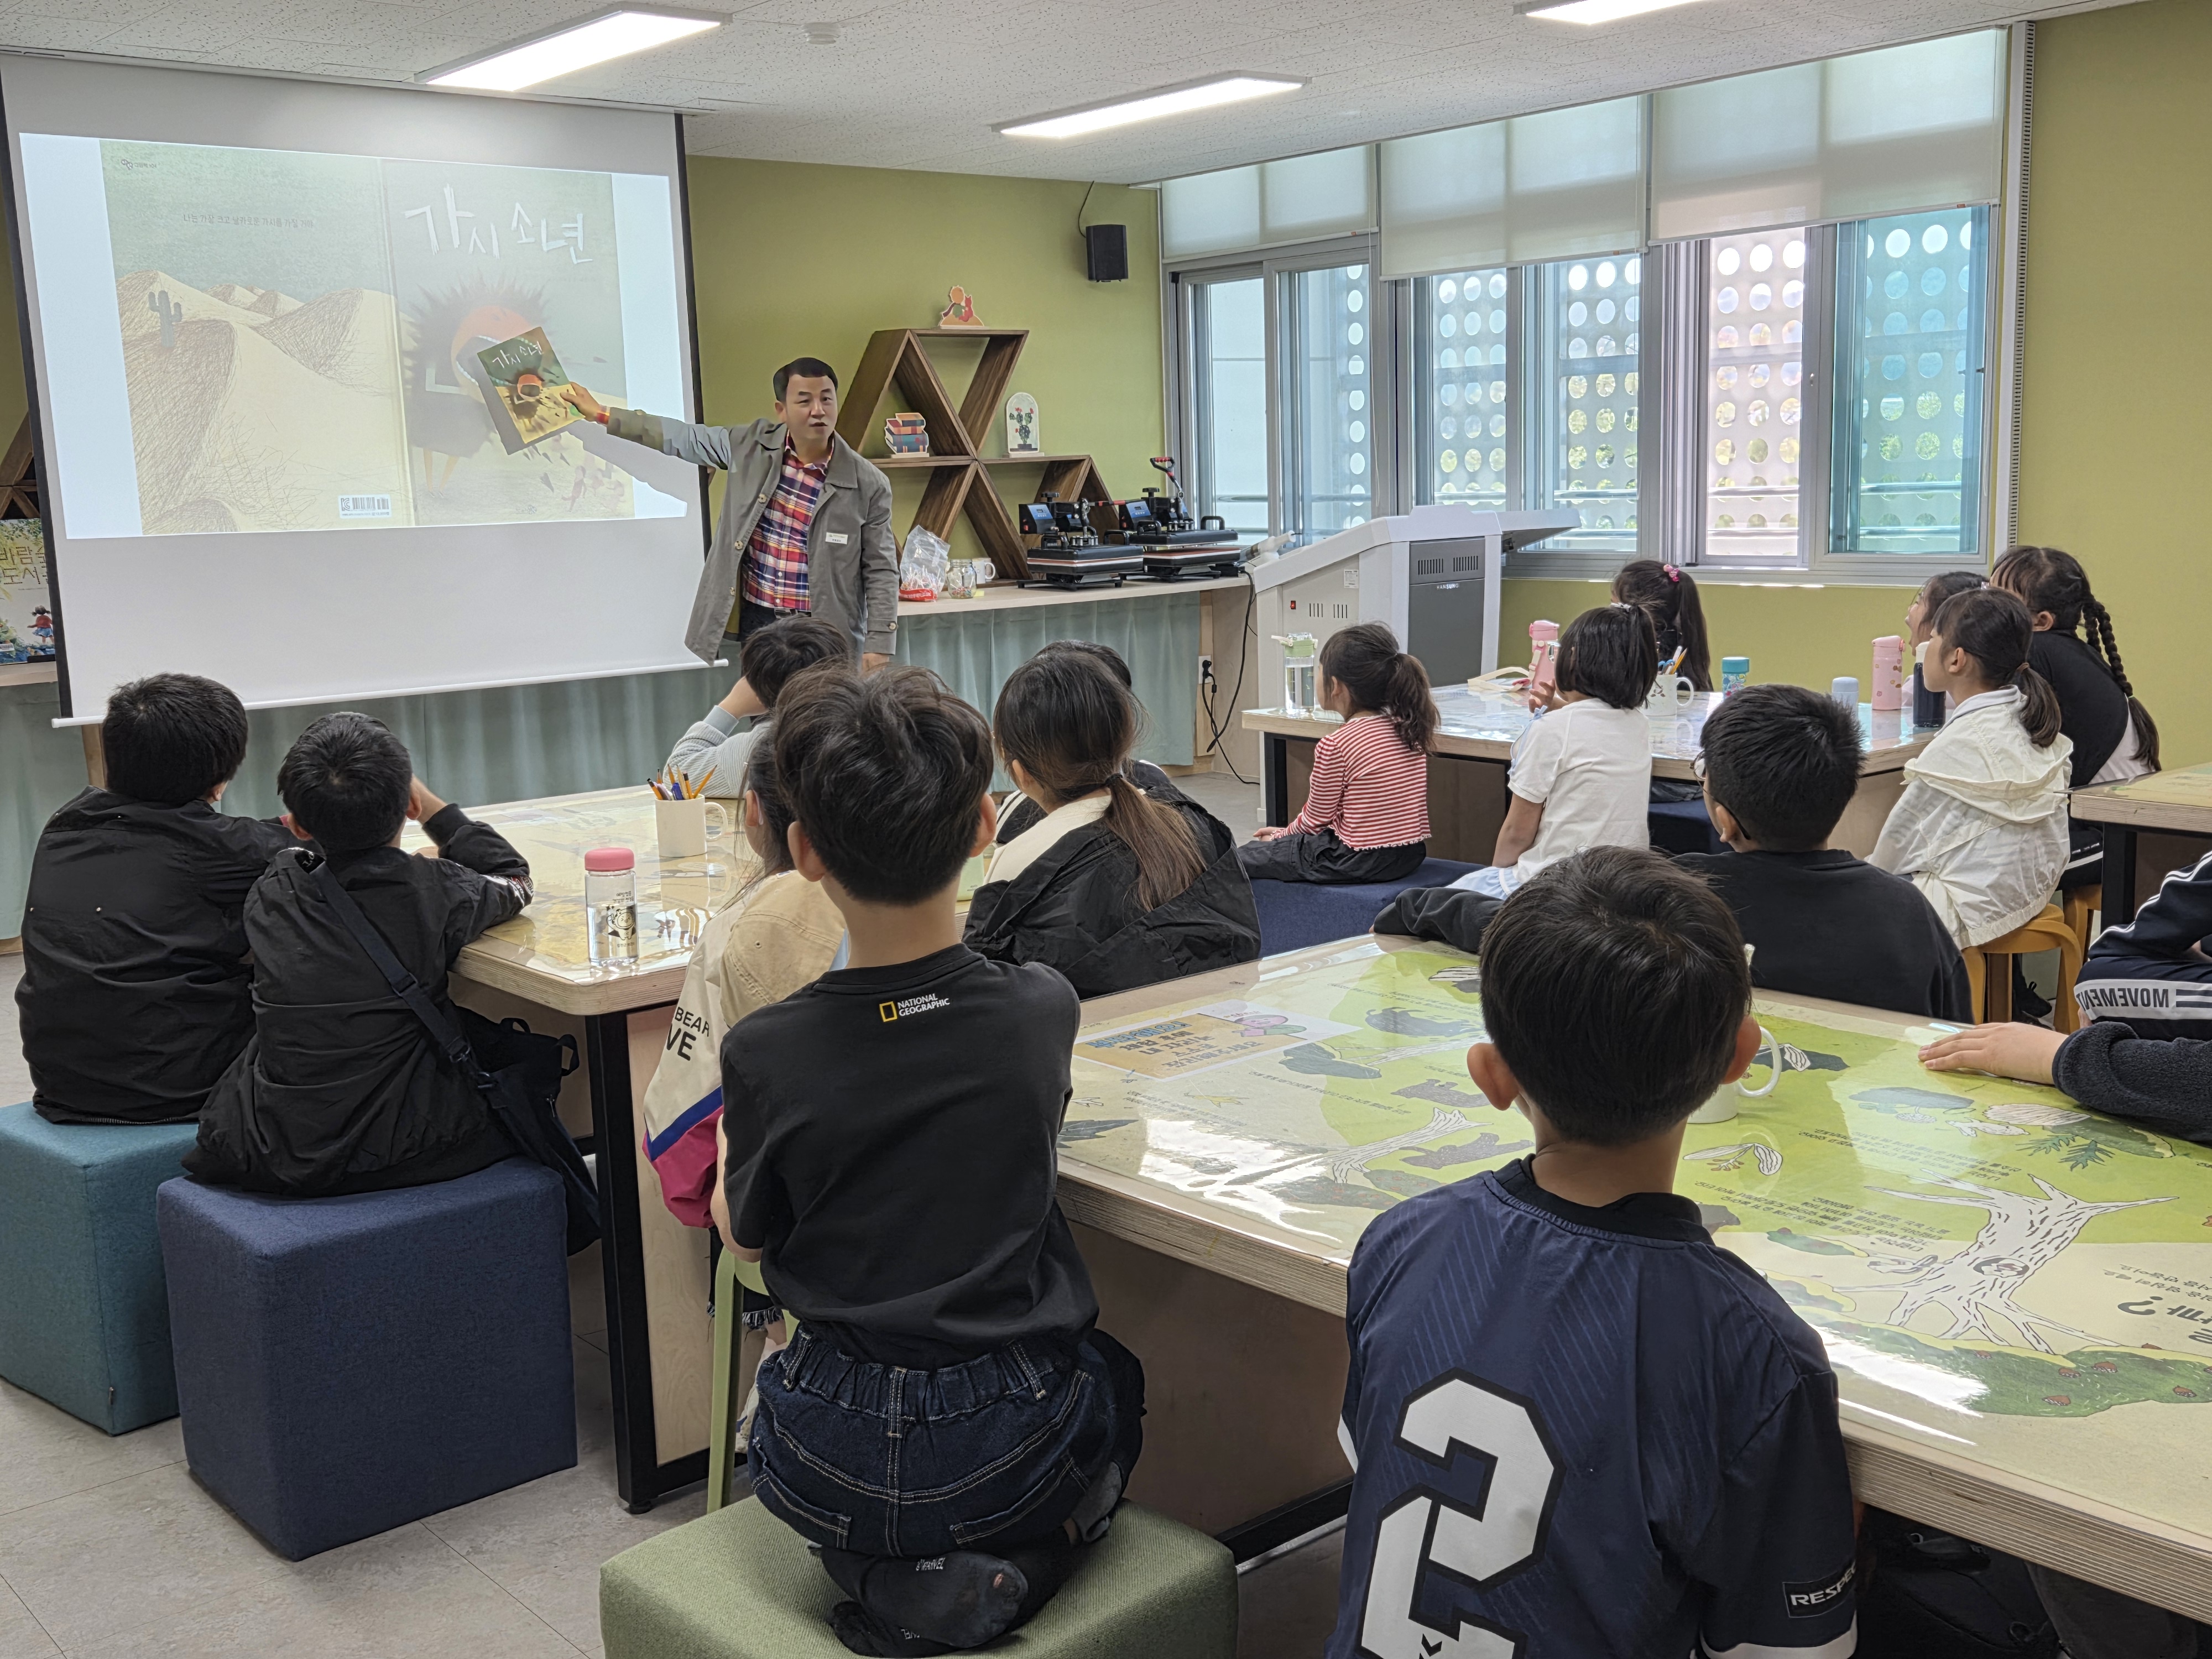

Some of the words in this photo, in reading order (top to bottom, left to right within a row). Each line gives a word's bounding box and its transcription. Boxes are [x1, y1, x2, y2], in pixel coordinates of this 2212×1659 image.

[183, 214, 198, 223] 나는
[200, 215, 215, 223] 가장
[232, 216, 260, 226] 날카로운
[262, 218, 283, 227] 가시를
[401, 183, 499, 260] 가시
[512, 202, 593, 264] 소년
[492, 349, 521, 368] 가시
[3, 566, 49, 585] 도서
[898, 993, 938, 1009] NATIONAL
[899, 998, 950, 1016] GEOGRAPHIC
[675, 1006, 709, 1037] BEAR
[1086, 1021, 1192, 1048] 부탁해요!
[1119, 1039, 1159, 1051] 체험
[1157, 1030, 1194, 1041] 후에
[1139, 1046, 1165, 1055] 내
[1160, 1035, 1216, 1050] 자리는
[1171, 1043, 1219, 1057] 스스로
[1162, 1040, 1265, 1068] 정리해주세요
[1798, 1130, 1827, 1141] 있어요.
[1947, 1154, 1989, 1165] 만들어서
[1978, 1166, 2010, 1177] 뿌리에
[1988, 1162, 2022, 1172] 산소를
[1969, 1170, 2001, 1181] 나무는
[1694, 1181, 1715, 1190] 터요.
[1736, 1192, 1786, 1208] 도토리에서
[1773, 1209, 1803, 1220] 창고에
[1805, 1218, 1828, 1227] 먹이
[1842, 1220, 1875, 1233] 창고를
[1854, 1215, 1900, 1229] 도토리를
[1829, 1224, 1871, 1238] 도토리를
[1876, 1228, 1898, 1237] 먹이
[1900, 1227, 1943, 1240] 다람쥐는
[1876, 1236, 1924, 1251] 다람쥐는
[1898, 1234, 1935, 1246] 그런데
[2135, 1278, 2181, 1293] 열심히
